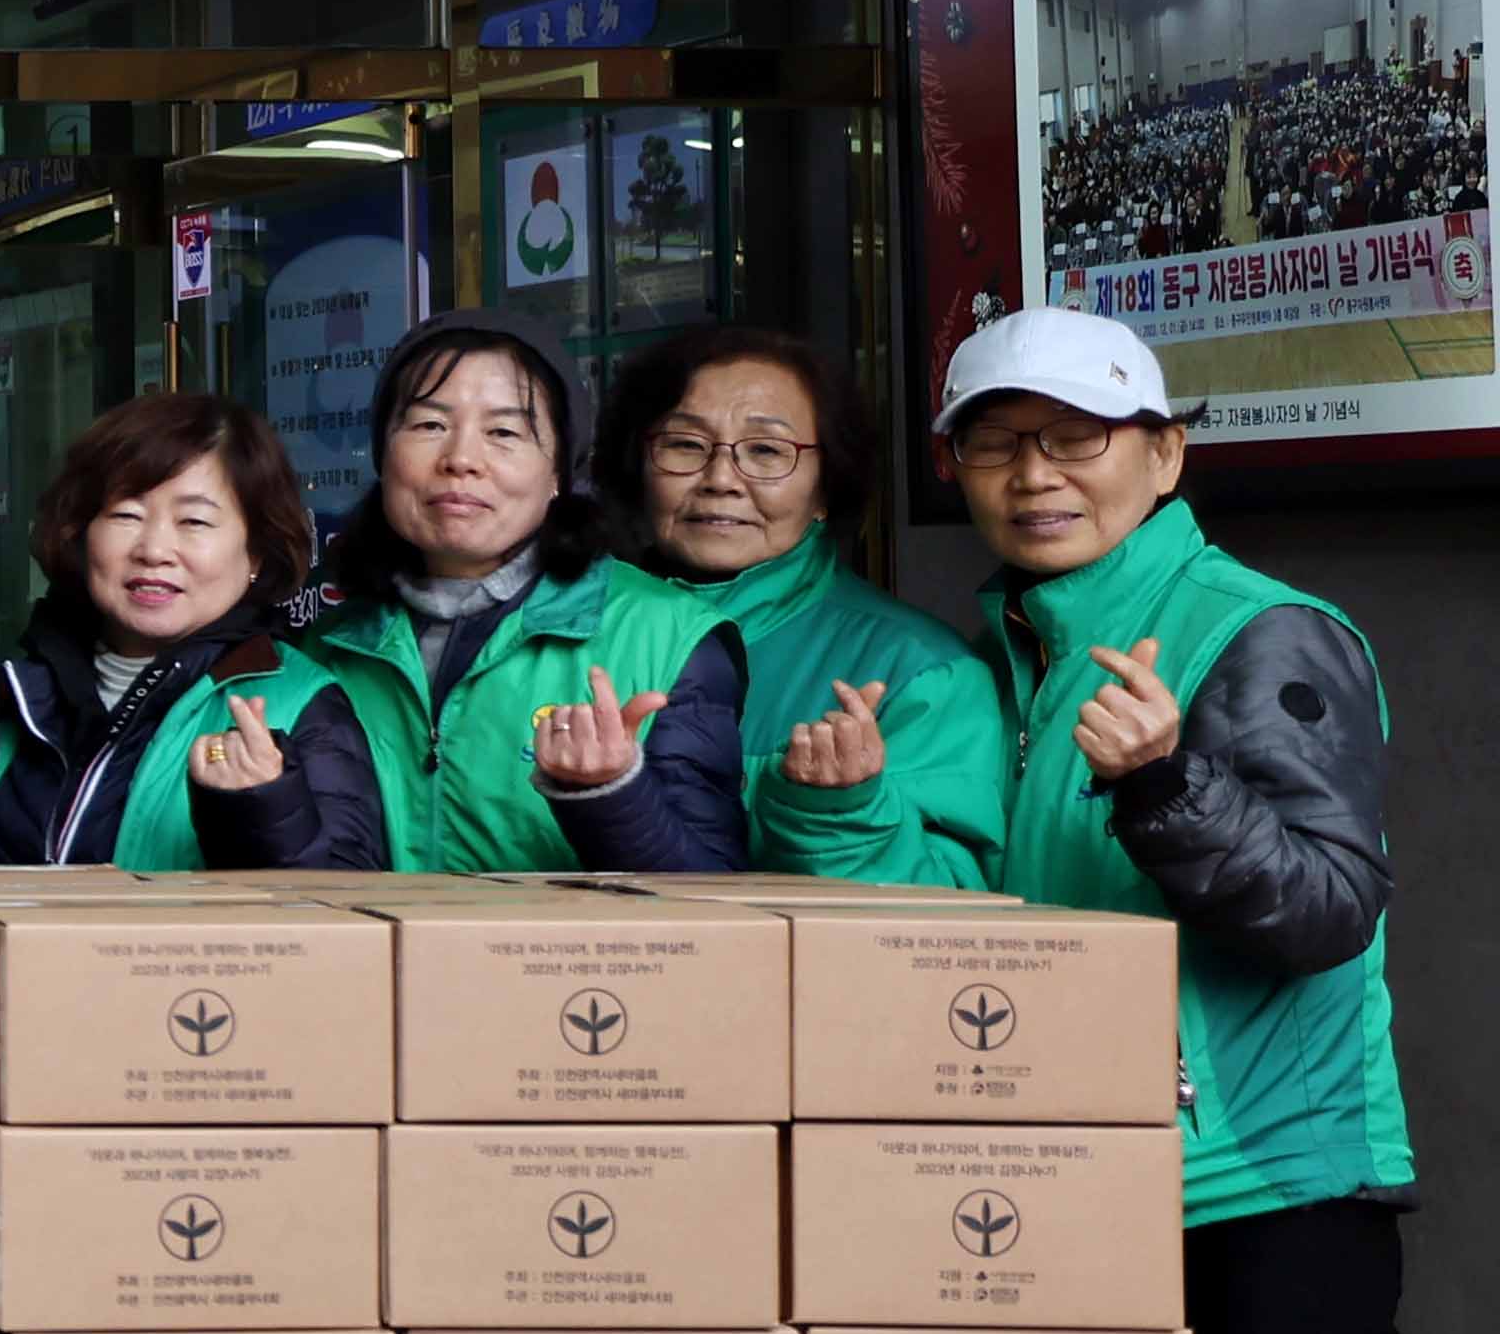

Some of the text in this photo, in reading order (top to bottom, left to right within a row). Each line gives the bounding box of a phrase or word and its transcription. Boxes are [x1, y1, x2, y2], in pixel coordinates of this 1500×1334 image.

[1095, 228, 1436, 317] 제18회 동구 자원봉사자의 날 기념식
[1453, 251, 1474, 283] 축
[1227, 404, 1300, 428] 자원봉사자의
[1305, 402, 1317, 423] 날
[1323, 399, 1360, 421] 기념식
